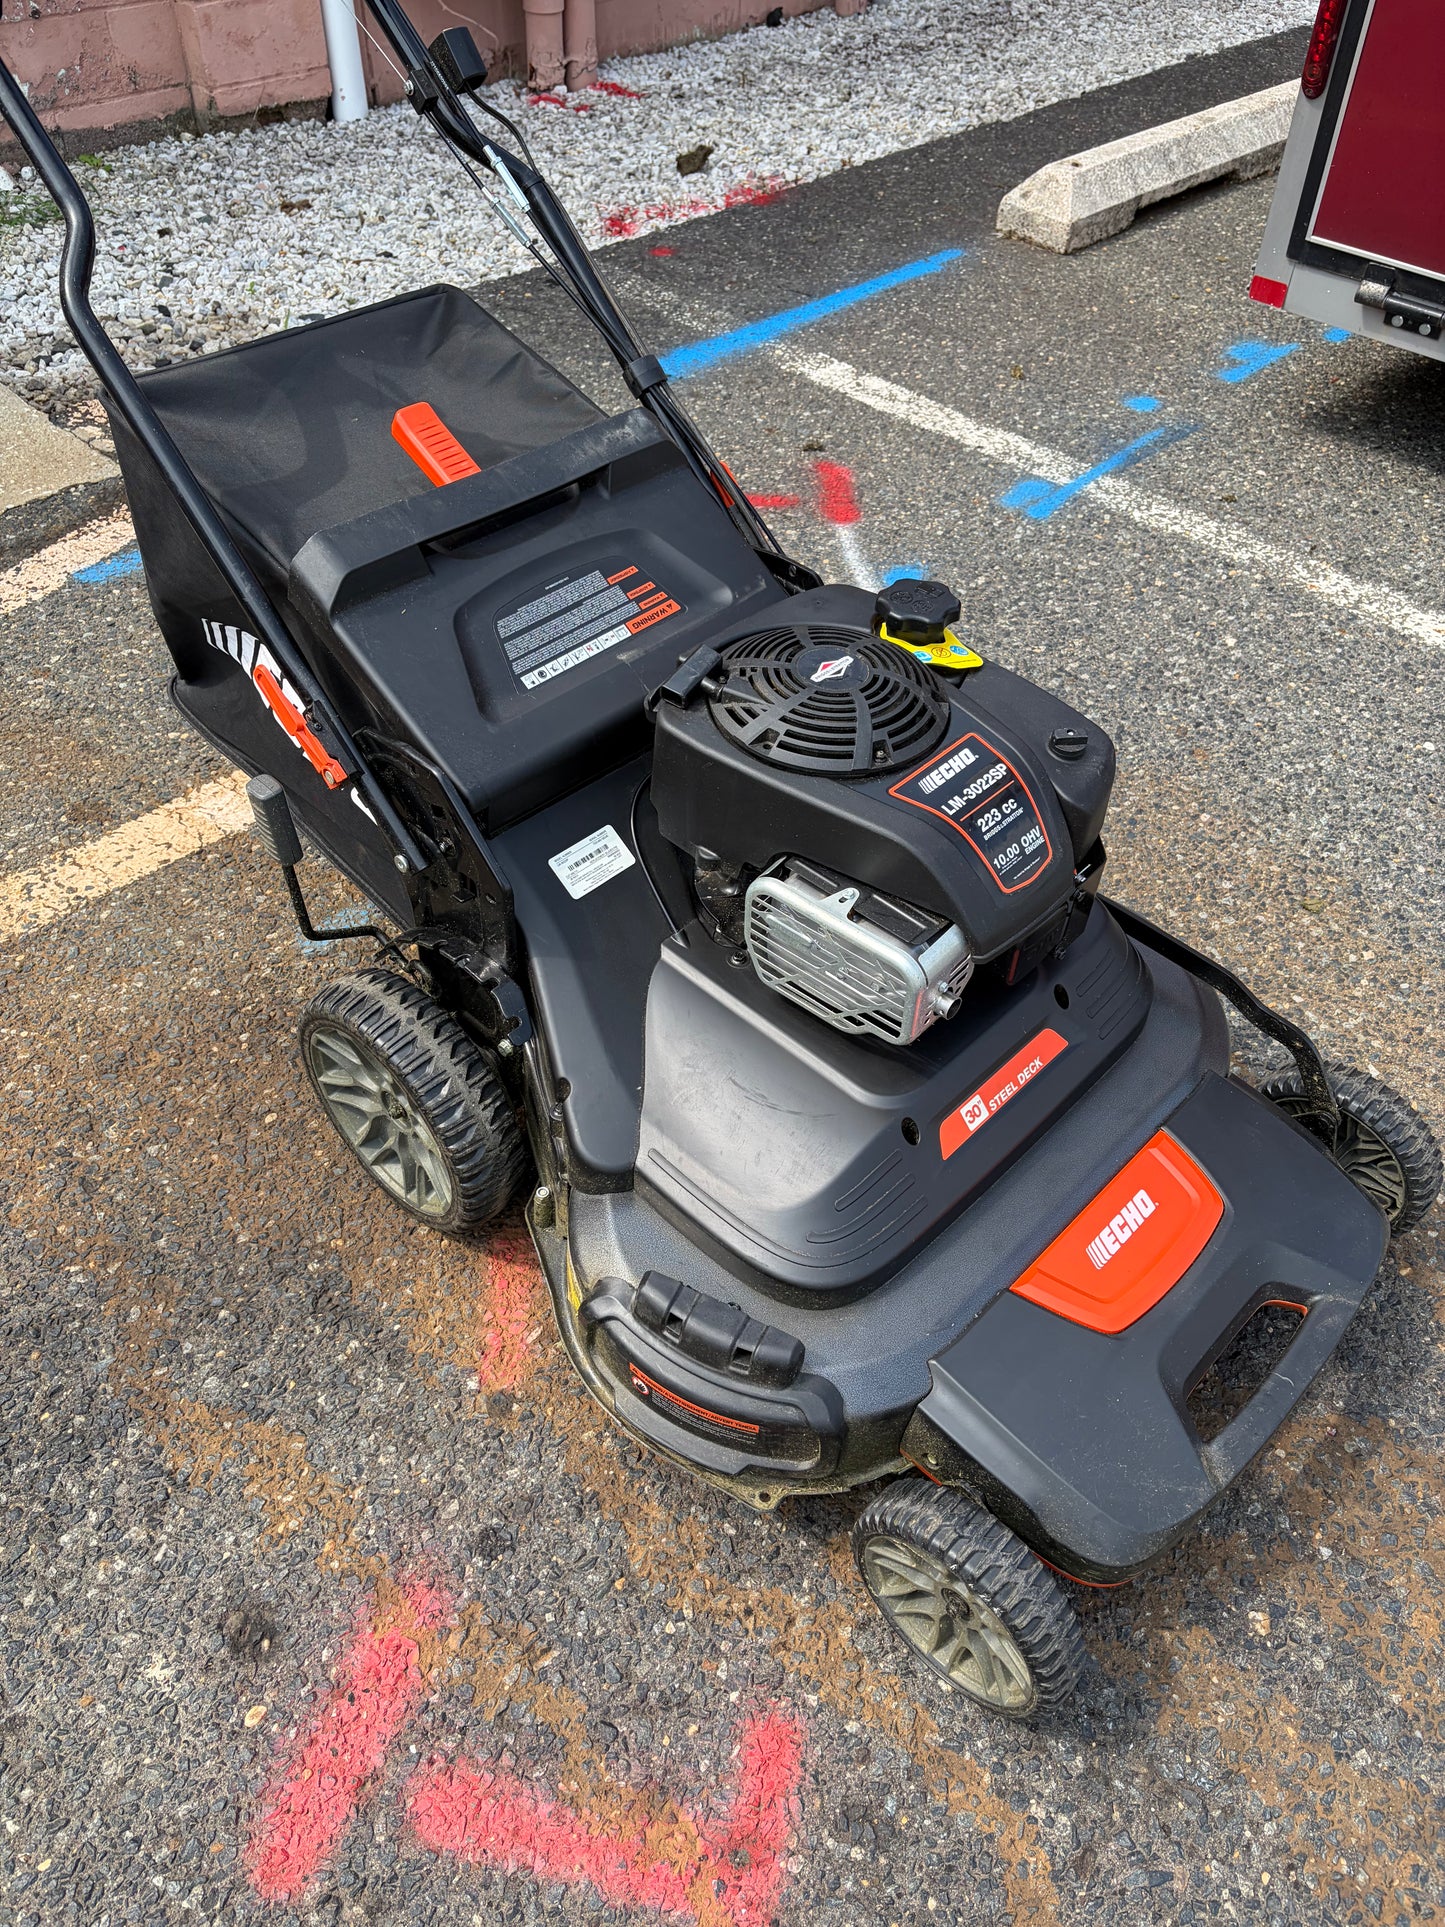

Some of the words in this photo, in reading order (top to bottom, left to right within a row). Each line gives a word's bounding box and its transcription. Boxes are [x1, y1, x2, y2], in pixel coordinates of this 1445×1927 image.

[632, 607, 668, 630] WARNING
[929, 747, 977, 788] ECHO
[941, 763, 1008, 816] LM-3022SP
[976, 808, 1002, 833] 223
[993, 844, 1020, 869] 10.00
[1021, 825, 1042, 848] OHV
[1025, 835, 1045, 855] ENGINE
[988, 1081, 1018, 1112] STEEL
[1017, 1056, 1044, 1085] DECK
[1098, 1189, 1158, 1256] ECHO
